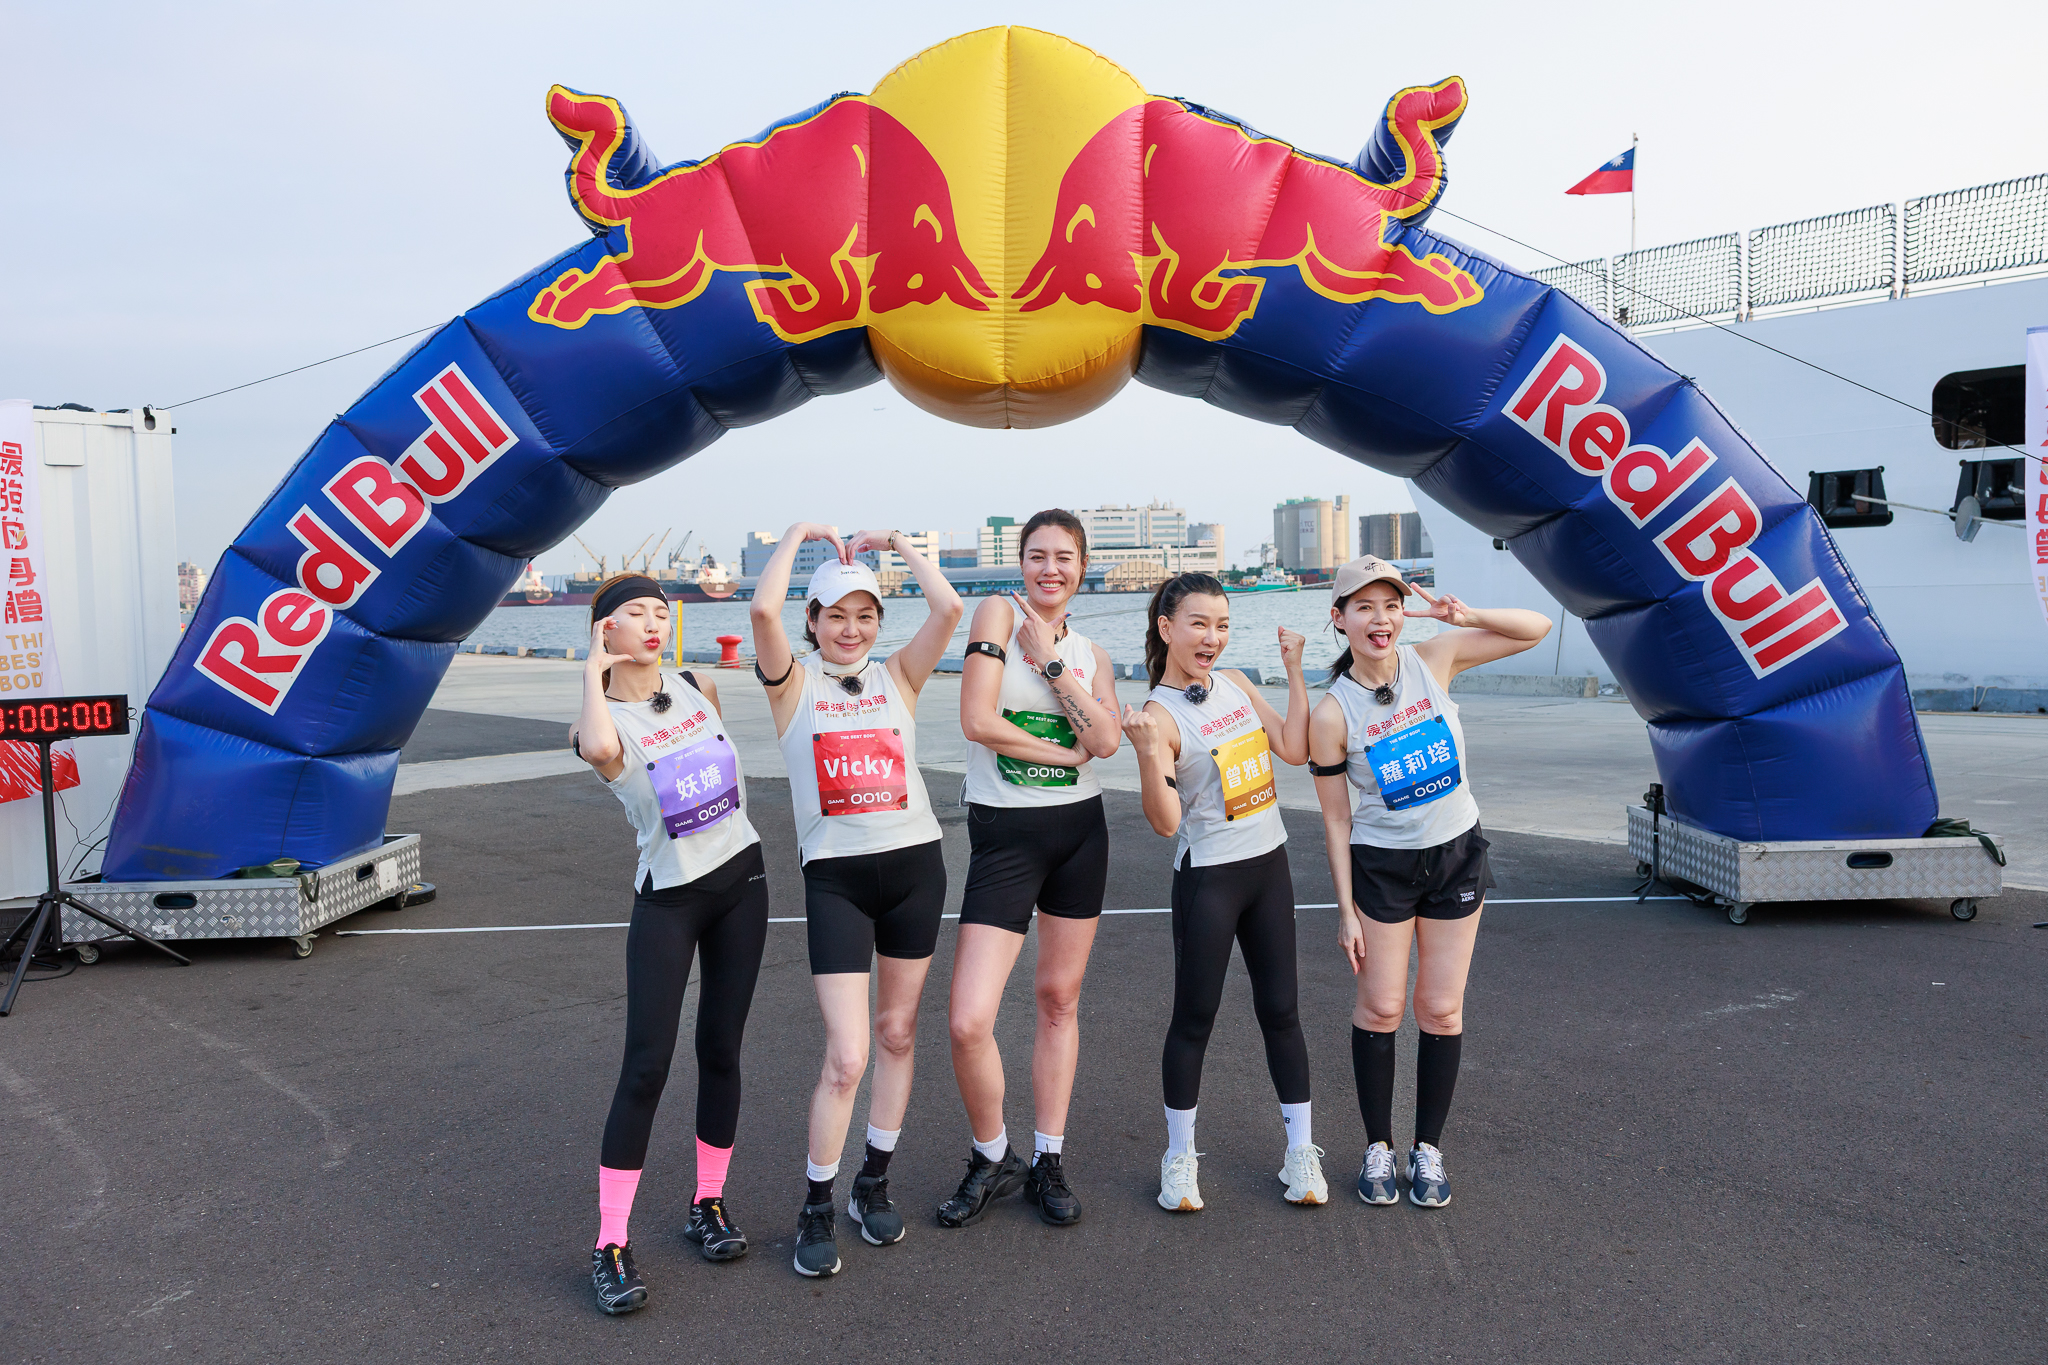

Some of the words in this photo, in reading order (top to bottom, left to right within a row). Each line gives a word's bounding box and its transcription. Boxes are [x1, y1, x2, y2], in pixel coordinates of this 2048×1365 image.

[1502, 334, 1718, 528] Red
[1653, 477, 1849, 679] Bull
[194, 505, 381, 716] Red
[322, 362, 519, 557] Bull
[0, 651, 43, 672] BES
[0, 671, 43, 692] BOD
[0, 701, 112, 734] :00:00
[1366, 698, 1432, 737] 最強的身體
[1392, 723, 1407, 734] BEST
[1409, 714, 1426, 726] BODY
[823, 754, 894, 779] Vicky
[1027, 767, 1066, 778] 0010
[1225, 750, 1271, 789] 曾雅蘭
[1379, 739, 1451, 785] 蘿莉塔
[675, 763, 722, 801] 妖嬌
[1250, 786, 1273, 805] 0010
[1414, 776, 1452, 797] 0010
[850, 791, 892, 805] 0010
[675, 819, 693, 828] GAME
[698, 798, 729, 821] 0010
